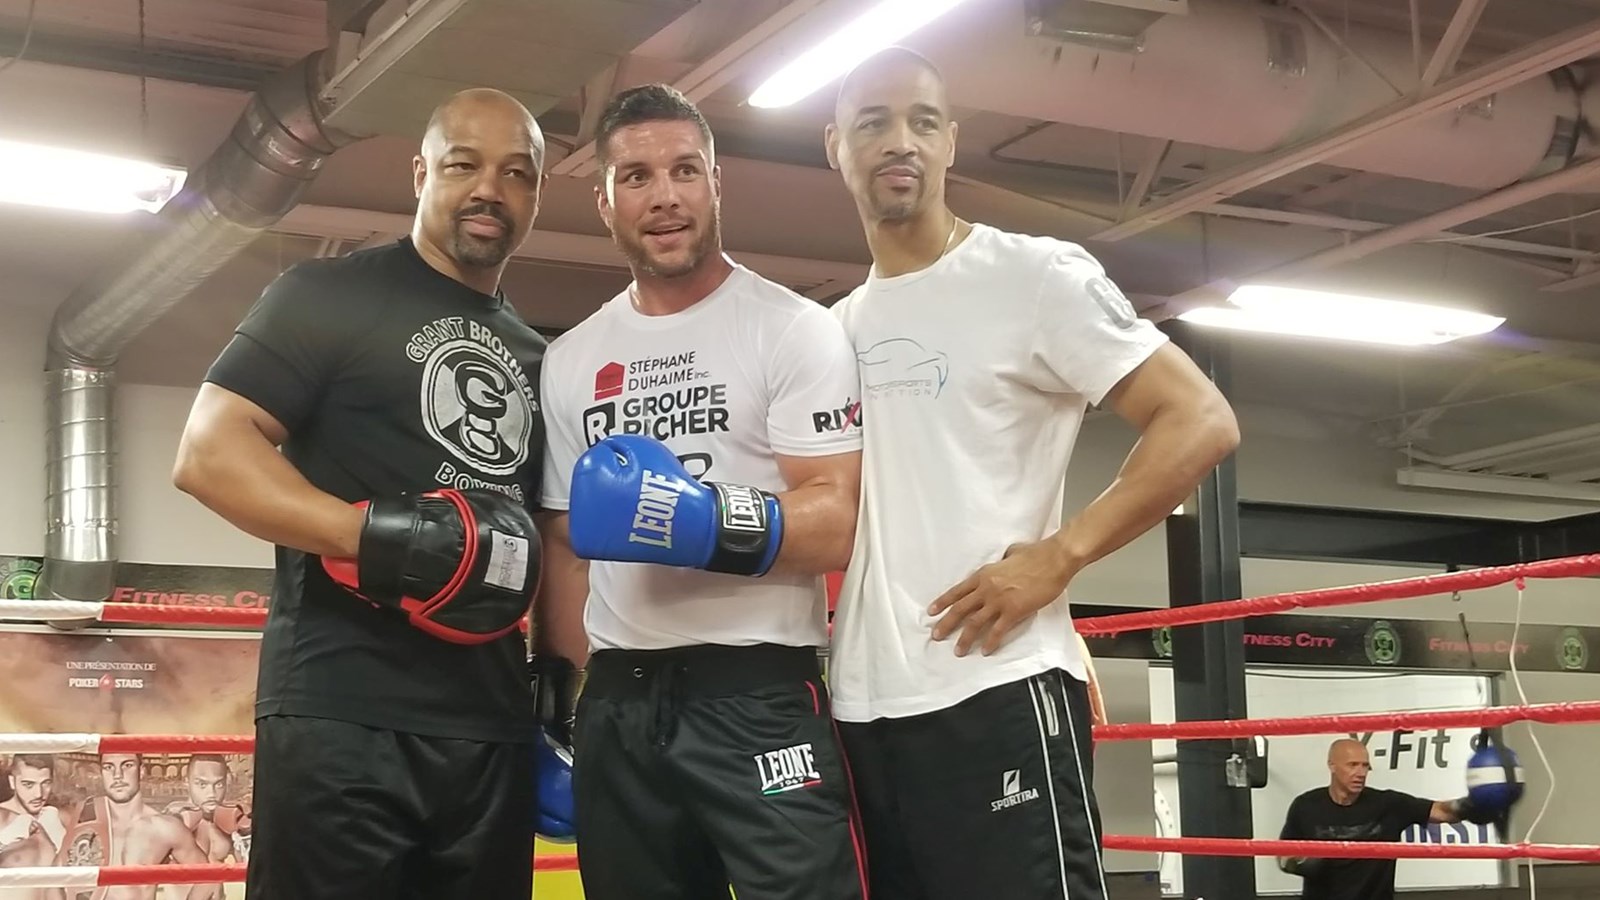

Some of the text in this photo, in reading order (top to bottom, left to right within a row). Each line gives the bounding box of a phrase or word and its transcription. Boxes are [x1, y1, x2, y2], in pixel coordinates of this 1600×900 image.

[406, 317, 539, 412] GRANT BROTHERS
[629, 351, 696, 374] STÉPHANE
[628, 368, 694, 391] DUHAIME
[623, 384, 727, 418] GROUPE
[623, 408, 730, 441] RICHER
[628, 469, 684, 549] LEONE
[112, 586, 270, 609] FITNESS CI
[1243, 632, 1336, 648] TNESS CITY
[69, 678, 143, 688] POKER STARS
[754, 743, 821, 791] LEONE
